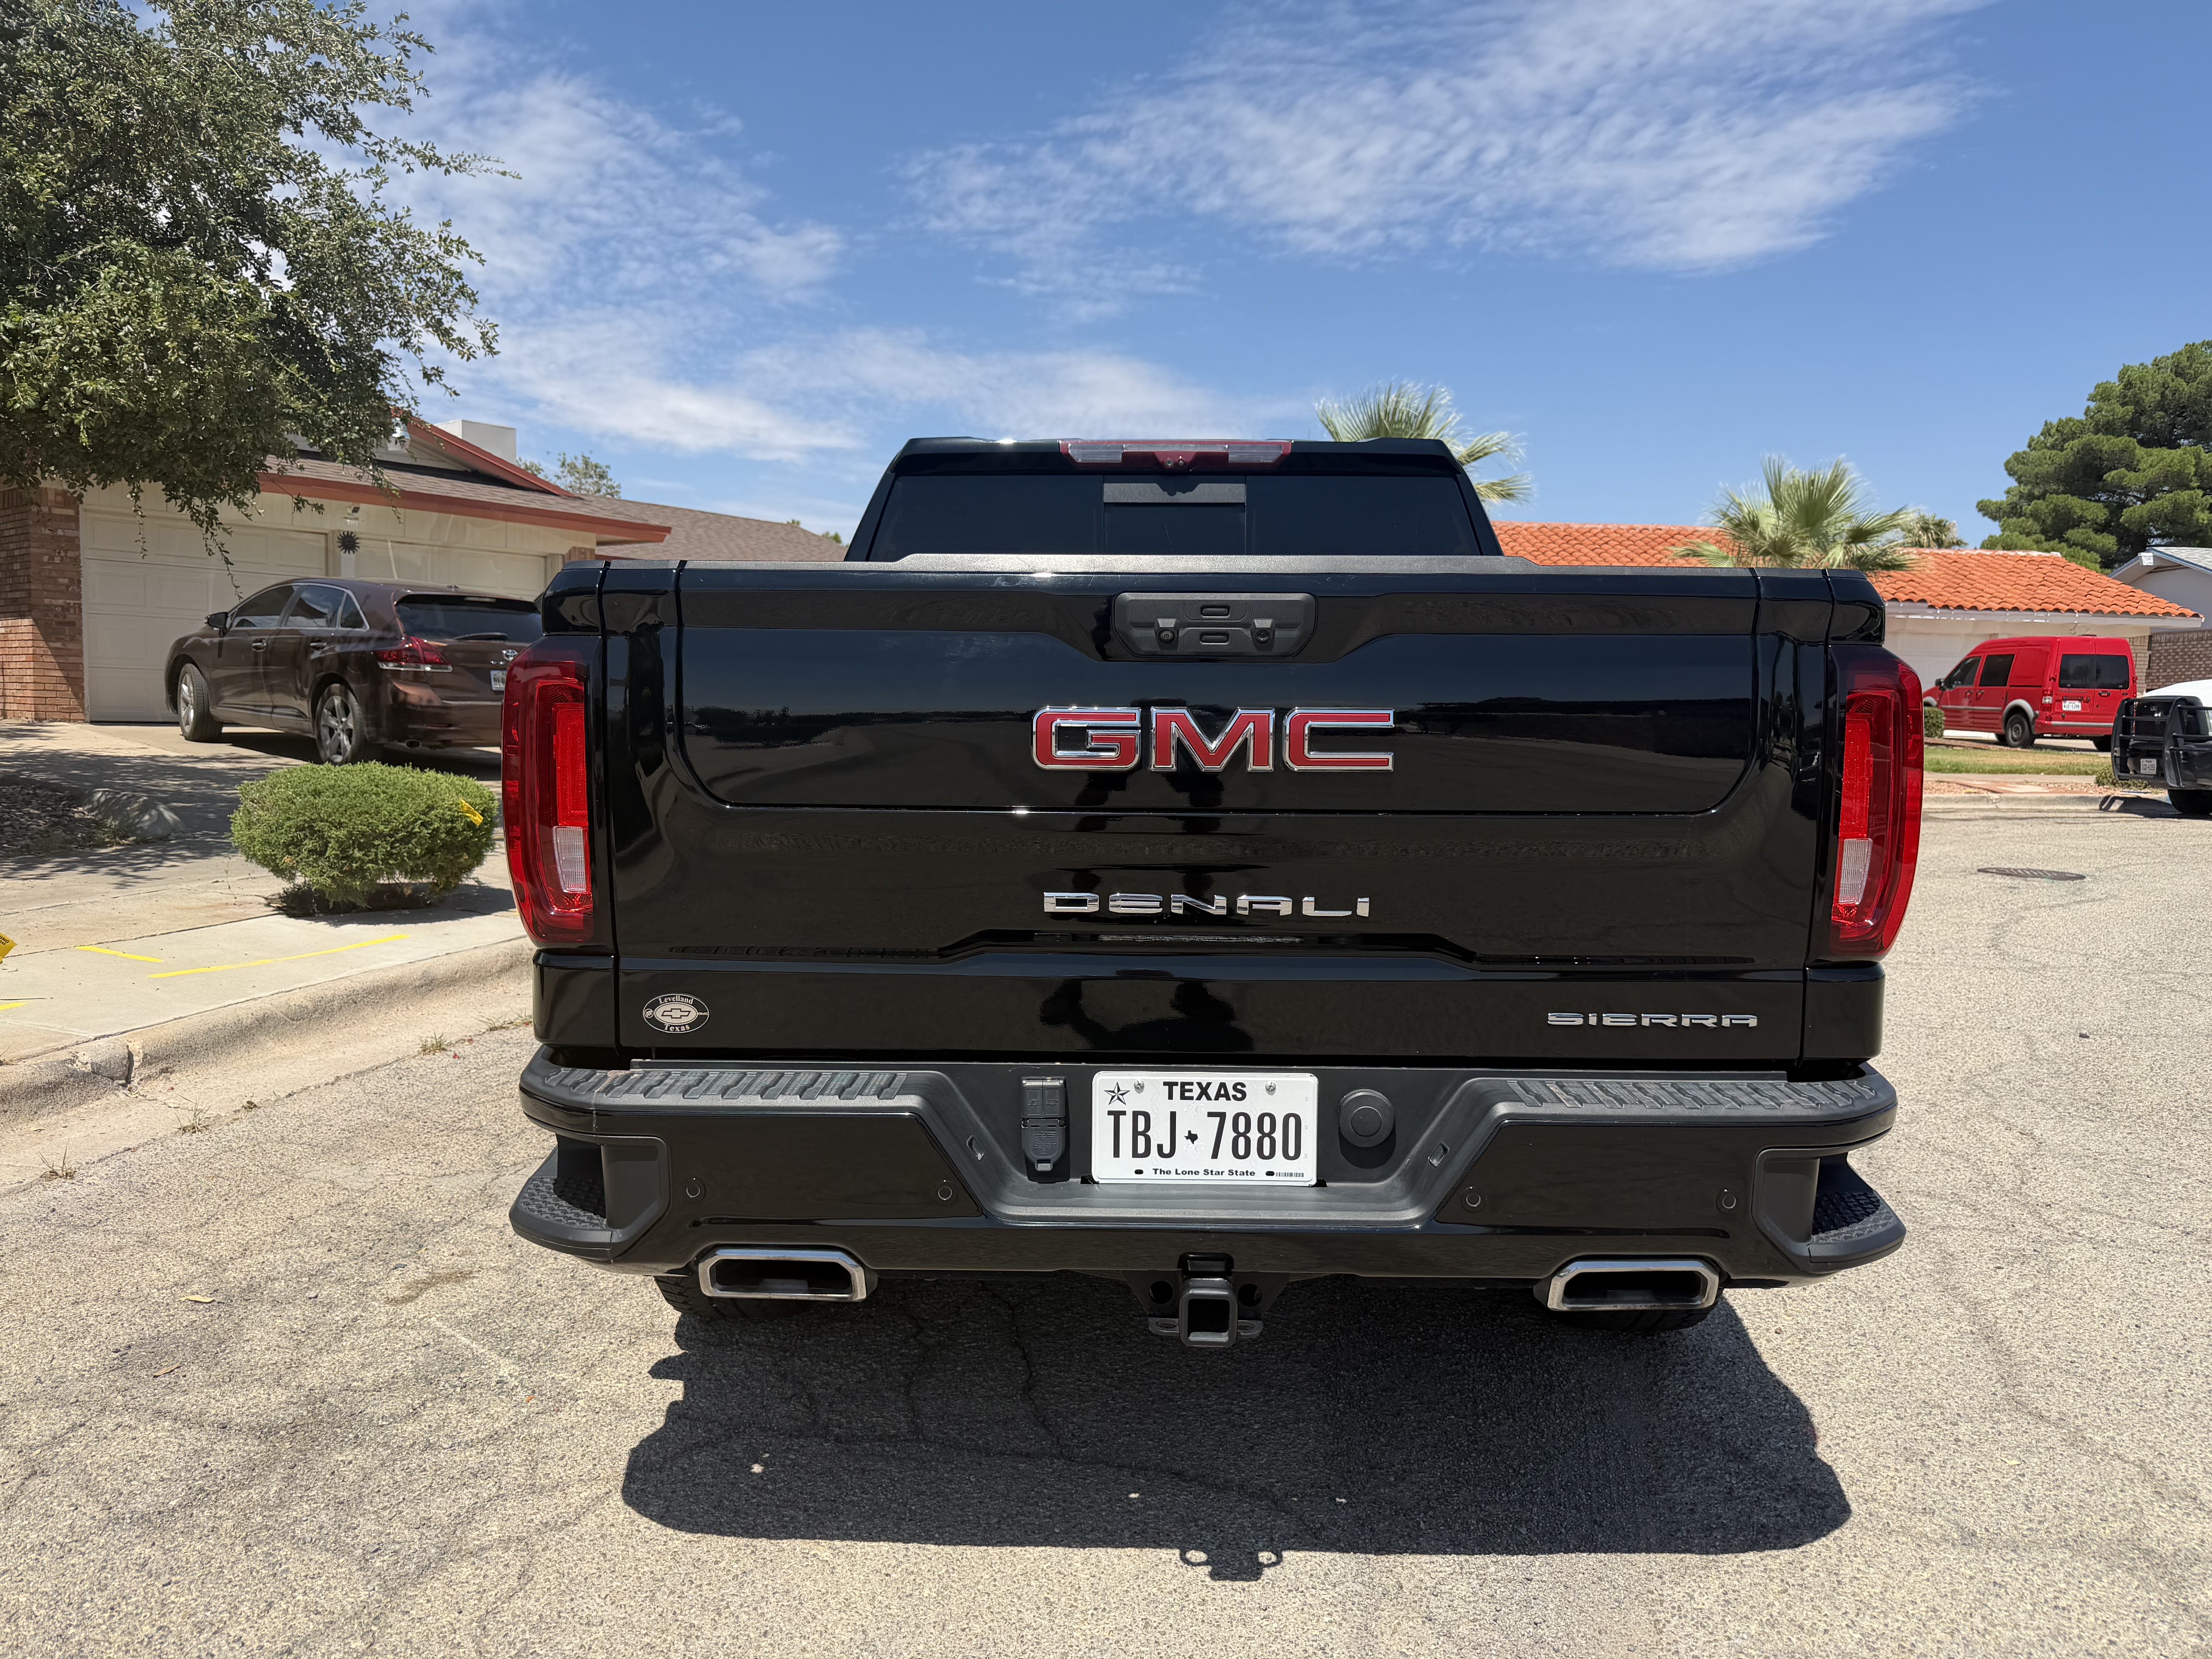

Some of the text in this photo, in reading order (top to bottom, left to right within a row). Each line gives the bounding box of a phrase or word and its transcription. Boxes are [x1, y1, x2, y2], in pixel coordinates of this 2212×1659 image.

[1032, 706, 1395, 772] GMC
[1044, 892, 1369, 917] DENALI
[659, 995, 694, 1005] Levelland
[1547, 1013, 1757, 1027] SIERRA
[1163, 1081, 1247, 1101] TEXAS
[1107, 1110, 1302, 1160] TBJ 7880
